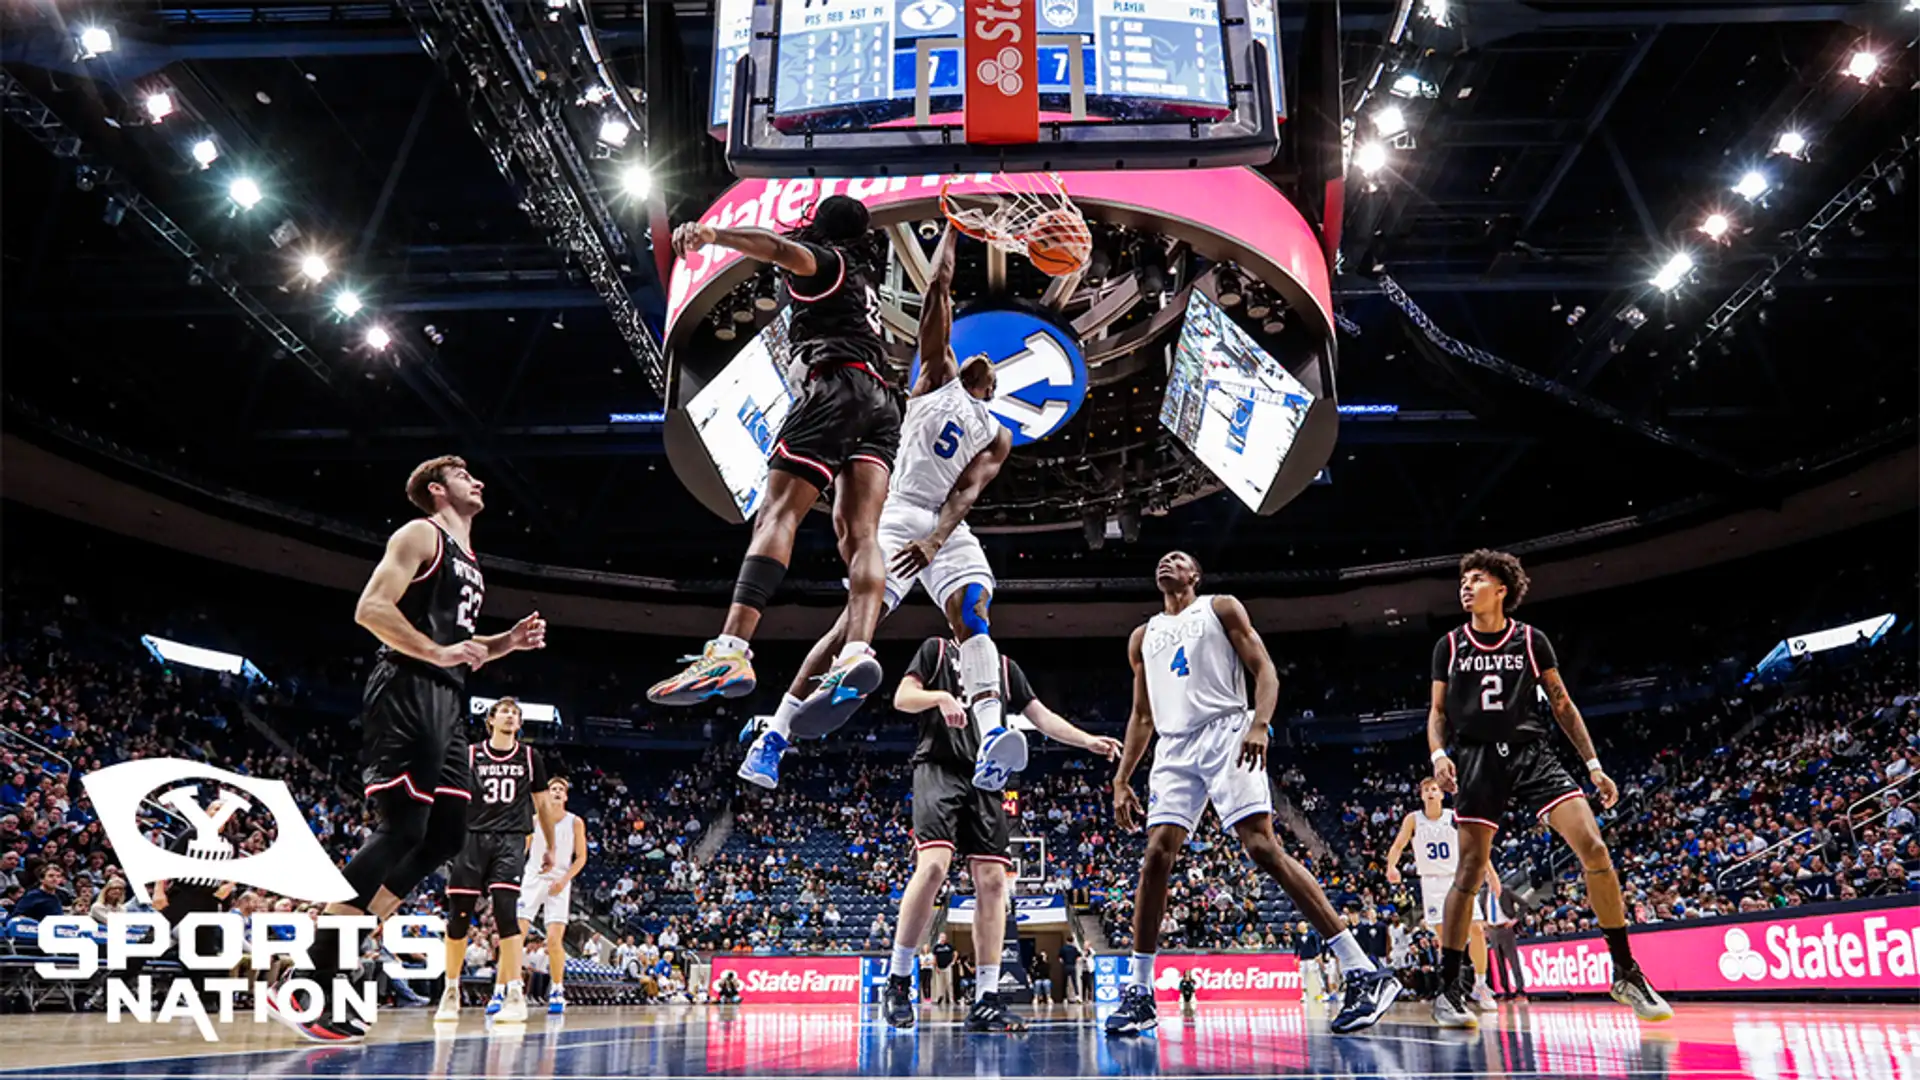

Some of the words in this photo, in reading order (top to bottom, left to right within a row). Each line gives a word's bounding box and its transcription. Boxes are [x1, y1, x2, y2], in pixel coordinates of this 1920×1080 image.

[804, 14, 821, 26] PTS
[850, 8, 866, 20] AST
[1113, 1, 1145, 13] PLAYER
[1189, 8, 1206, 19] PTS
[1053, 53, 1068, 81] 7
[933, 420, 965, 460] 5
[1150, 620, 1206, 659] BYU
[1170, 645, 1191, 678] 4
[1458, 653, 1525, 672] WOLVES
[1480, 673, 1505, 711] 2
[477, 763, 525, 777] WOLVES
[482, 777, 517, 804] 30
[1426, 841, 1451, 860] 30
